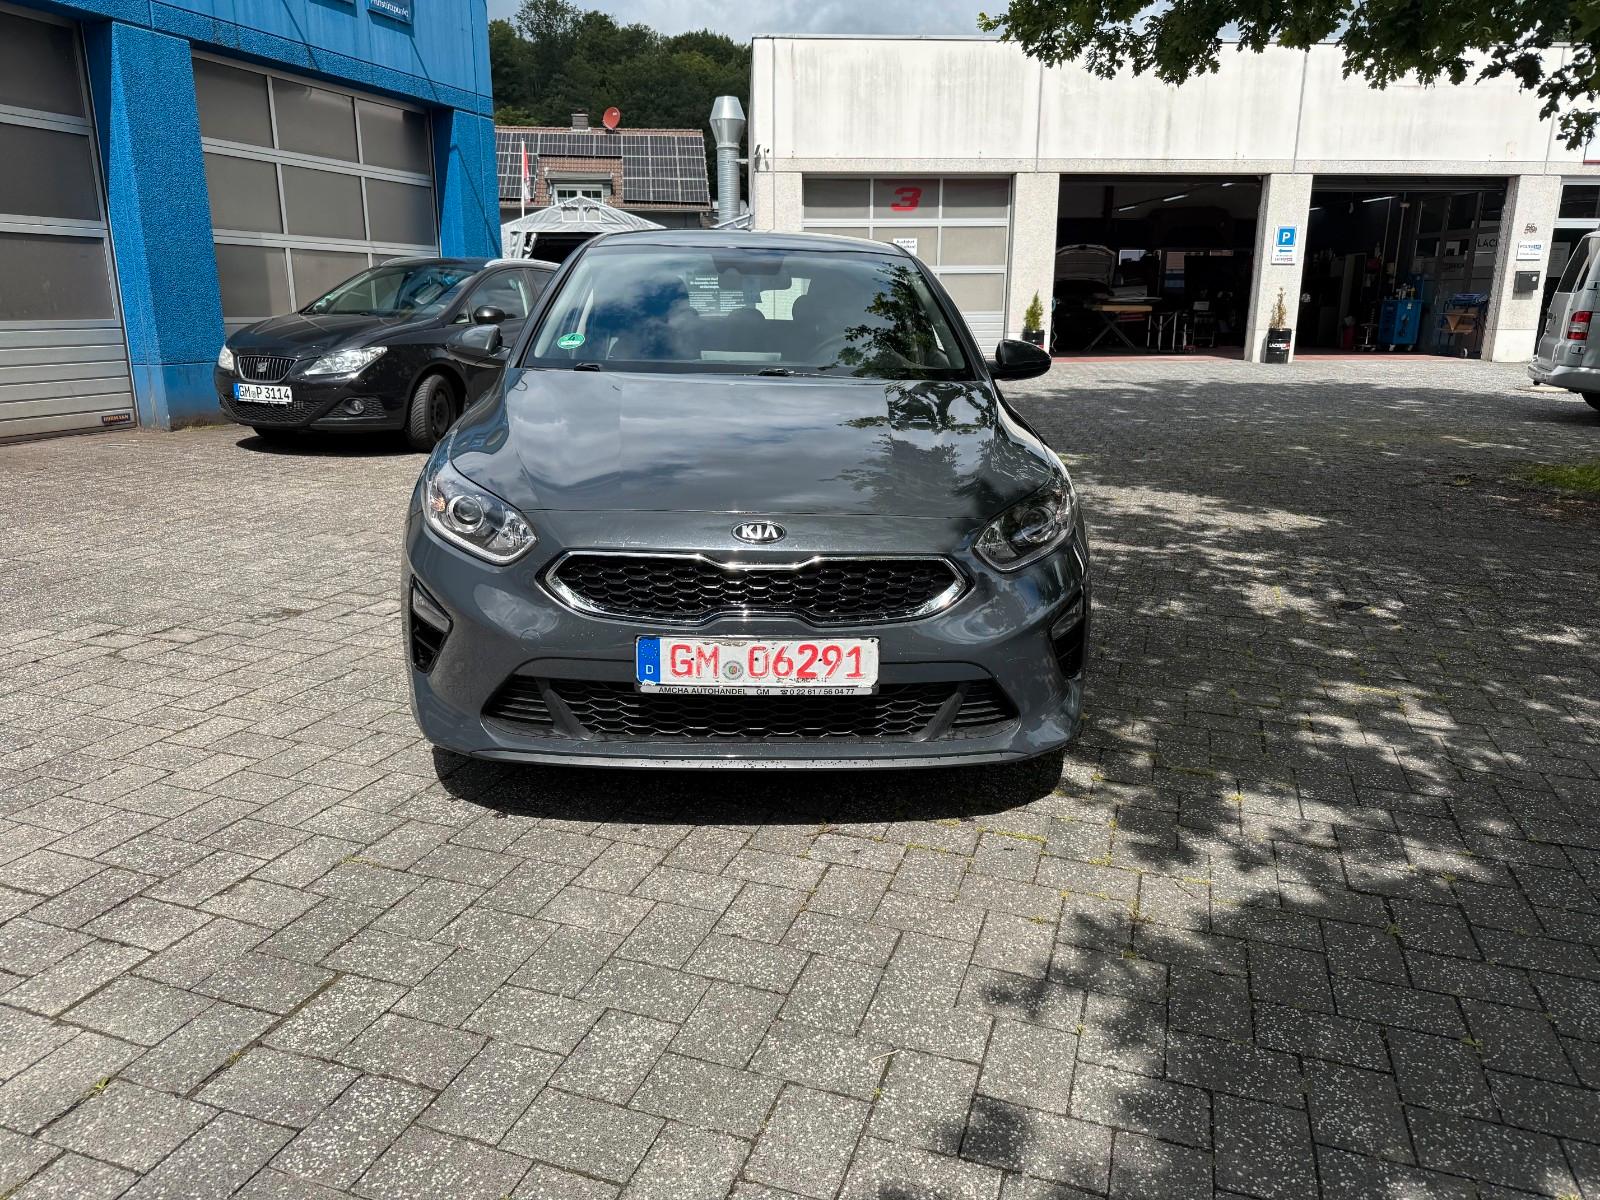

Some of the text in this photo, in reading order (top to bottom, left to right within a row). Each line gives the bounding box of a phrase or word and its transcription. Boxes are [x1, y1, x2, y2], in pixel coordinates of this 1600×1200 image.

[891, 187, 922, 212] 3
[1282, 231, 1291, 243] P
[238, 385, 290, 400] GM P 3114
[741, 524, 778, 539] KIA
[645, 643, 864, 679] D GM 06291
[658, 686, 689, 695] AMCHA
[691, 687, 747, 695] AUTOHANDEL
[756, 688, 770, 696] GM
